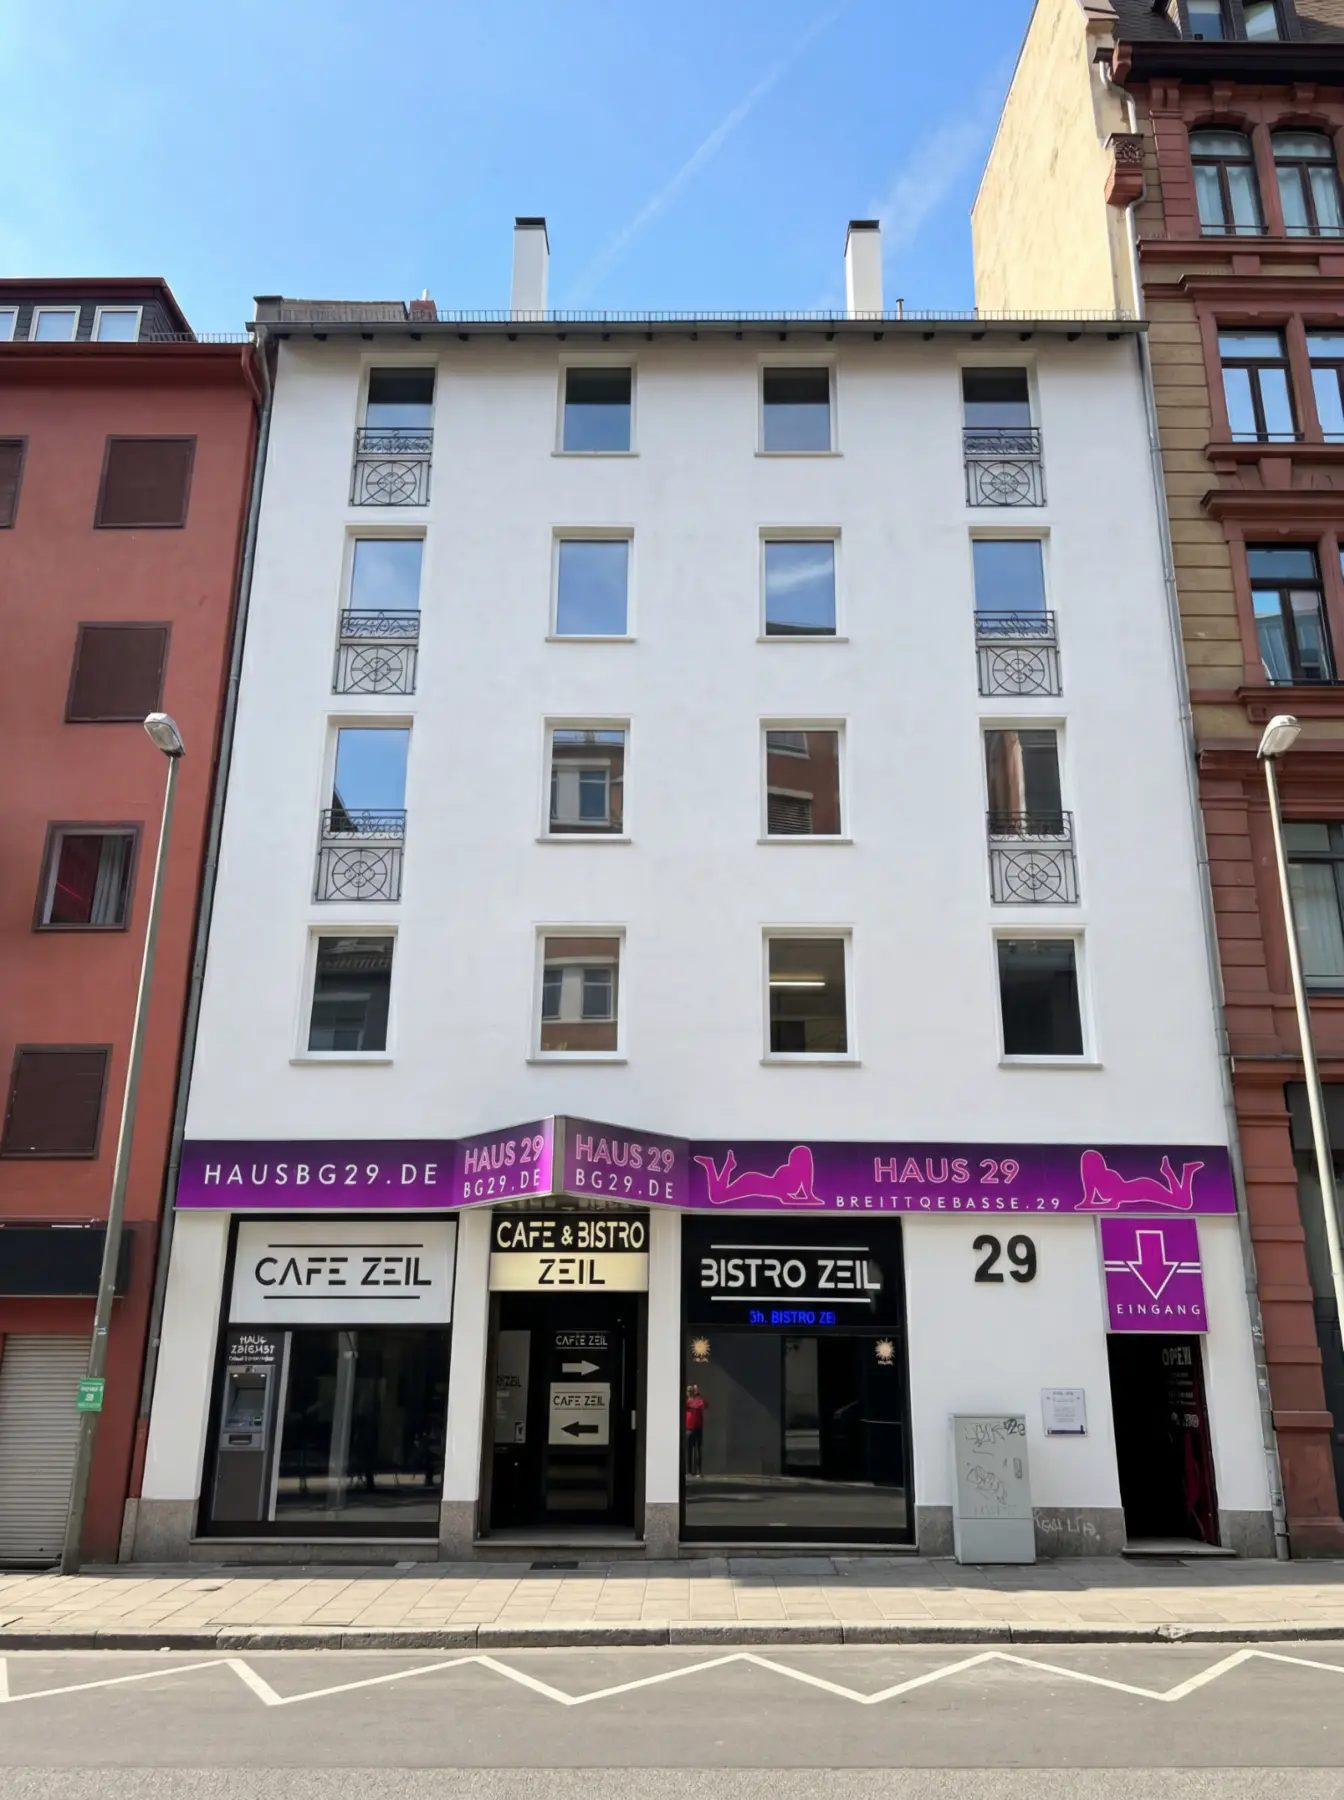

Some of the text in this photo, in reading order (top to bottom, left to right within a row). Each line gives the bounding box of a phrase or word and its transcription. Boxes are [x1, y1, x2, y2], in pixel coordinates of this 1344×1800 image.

[464, 1135, 544, 1174] HAUS 29
[575, 1134, 675, 1173] HAUS 29
[204, 1163, 438, 1186] HAUSBG29.DE
[874, 1157, 1020, 1184] HAUS 29
[497, 1221, 644, 1248] CAFE & BISTRO
[255, 1256, 432, 1286] CAFE ZEIL
[538, 1258, 605, 1285] ZEIL
[972, 1234, 1037, 1283] 29
[701, 1258, 881, 1289] BISTRO ZEIL
[772, 1310, 816, 1325] BISTRO
[1116, 1303, 1200, 1316] EINGANG
[552, 1395, 581, 1406] CAFE
